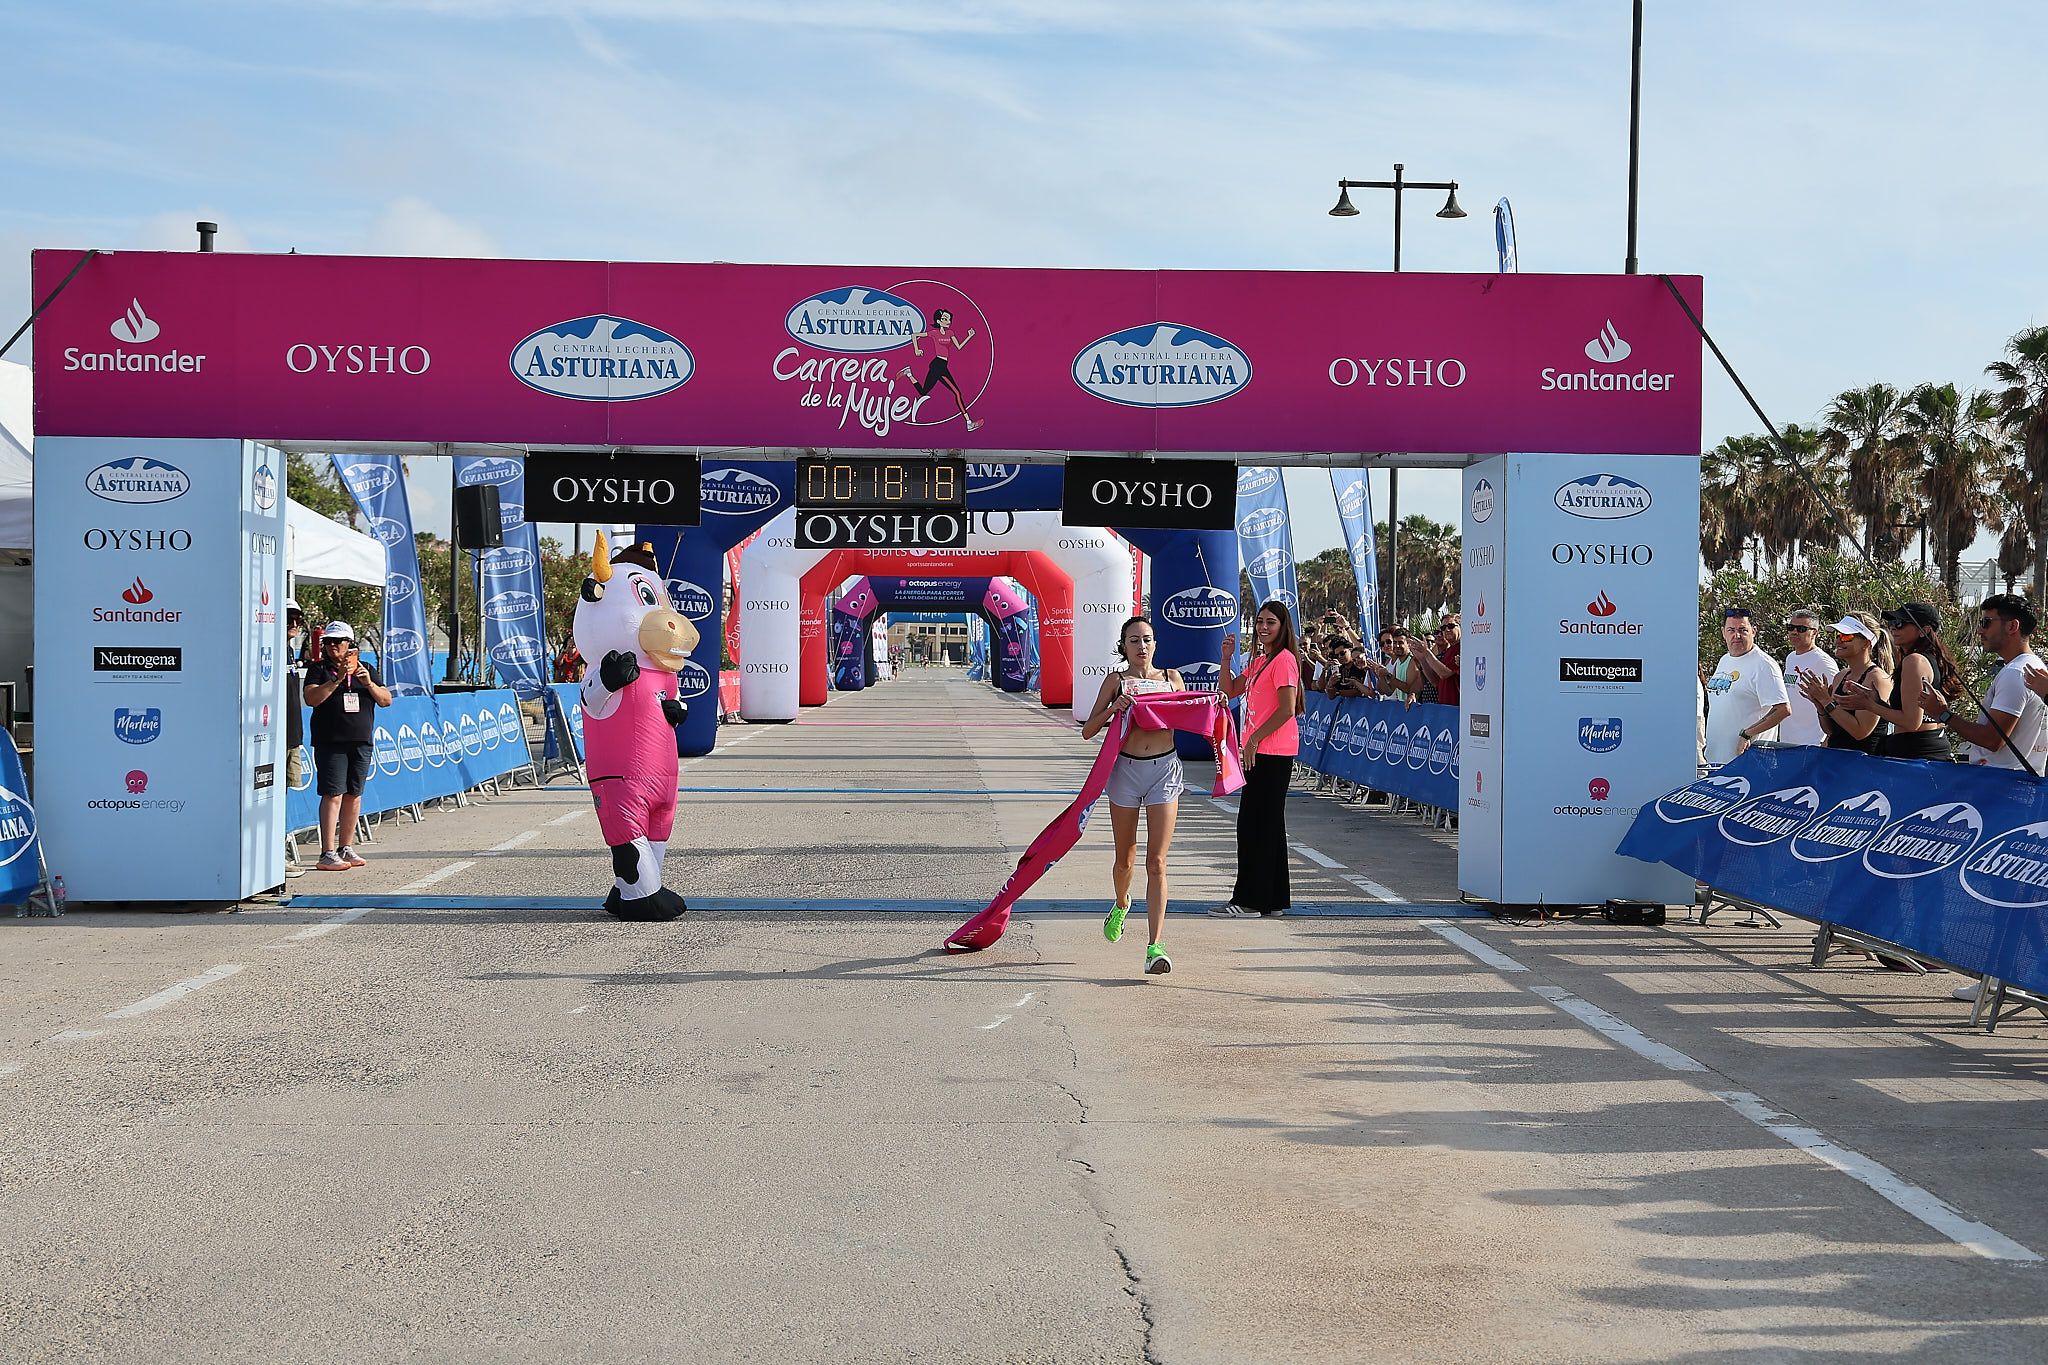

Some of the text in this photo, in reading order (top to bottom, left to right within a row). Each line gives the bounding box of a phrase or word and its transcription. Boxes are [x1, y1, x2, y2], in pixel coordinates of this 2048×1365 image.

[796, 309, 915, 336] ASTURIANA
[818, 308, 911, 317] CENTRAL LECHERA
[286, 343, 431, 375] OYSHO
[553, 344, 675, 355] CENTRAL LECHERA
[1114, 352, 1233, 361] CENTRAL LECHERA
[63, 347, 206, 373] Santander
[525, 345, 681, 379] ASTURIANA
[773, 346, 889, 383] Carrera
[1086, 353, 1239, 385] ASTURIANA
[1328, 357, 1467, 387] OYSHO
[1541, 367, 1675, 392] Santander
[800, 380, 931, 437] de la Mujer
[94, 473, 183, 492] ASTURIANA
[552, 476, 675, 505] OYSHO
[808, 465, 954, 500] 00:18:18
[700, 488, 772, 505] STURIANA
[1092, 479, 1212, 509] OYSHO
[1561, 489, 1645, 508] ASTURIANA
[804, 514, 959, 544] OYSHO
[84, 528, 192, 551] OYSHO
[251, 531, 277, 556] OYSHO
[767, 537, 792, 548] OYS
[1058, 538, 1105, 549] OYSHO
[1469, 544, 1495, 569] OYSHO
[1552, 543, 1653, 566] OYSHO
[908, 580, 962, 589] octopus energy
[93, 607, 183, 623] Santander
[674, 600, 709, 613] RIANA
[746, 600, 790, 611] OYSHO
[1051, 607, 1073, 615] Sports
[1082, 603, 1126, 614] OYSHO
[1167, 602, 1235, 618] ASTURIANA
[1559, 619, 1644, 635] Santander
[100, 651, 177, 669] Neutrogena
[746, 663, 789, 674] OYSHO
[1565, 662, 1637, 680] Neutrogena
[116, 715, 159, 735] Marlene
[1580, 725, 1620, 744] Marlene
[88, 799, 186, 813] octopus energy
[1663, 785, 1730, 814] ASTURIANA
[1553, 805, 1603, 818] octopus
[1726, 801, 1800, 836] ASTURIANA
[1798, 816, 1872, 848] ASTURIANA
[1871, 824, 1962, 865] ASTURIANA
[1966, 840, 2048, 889] ASTURIA
